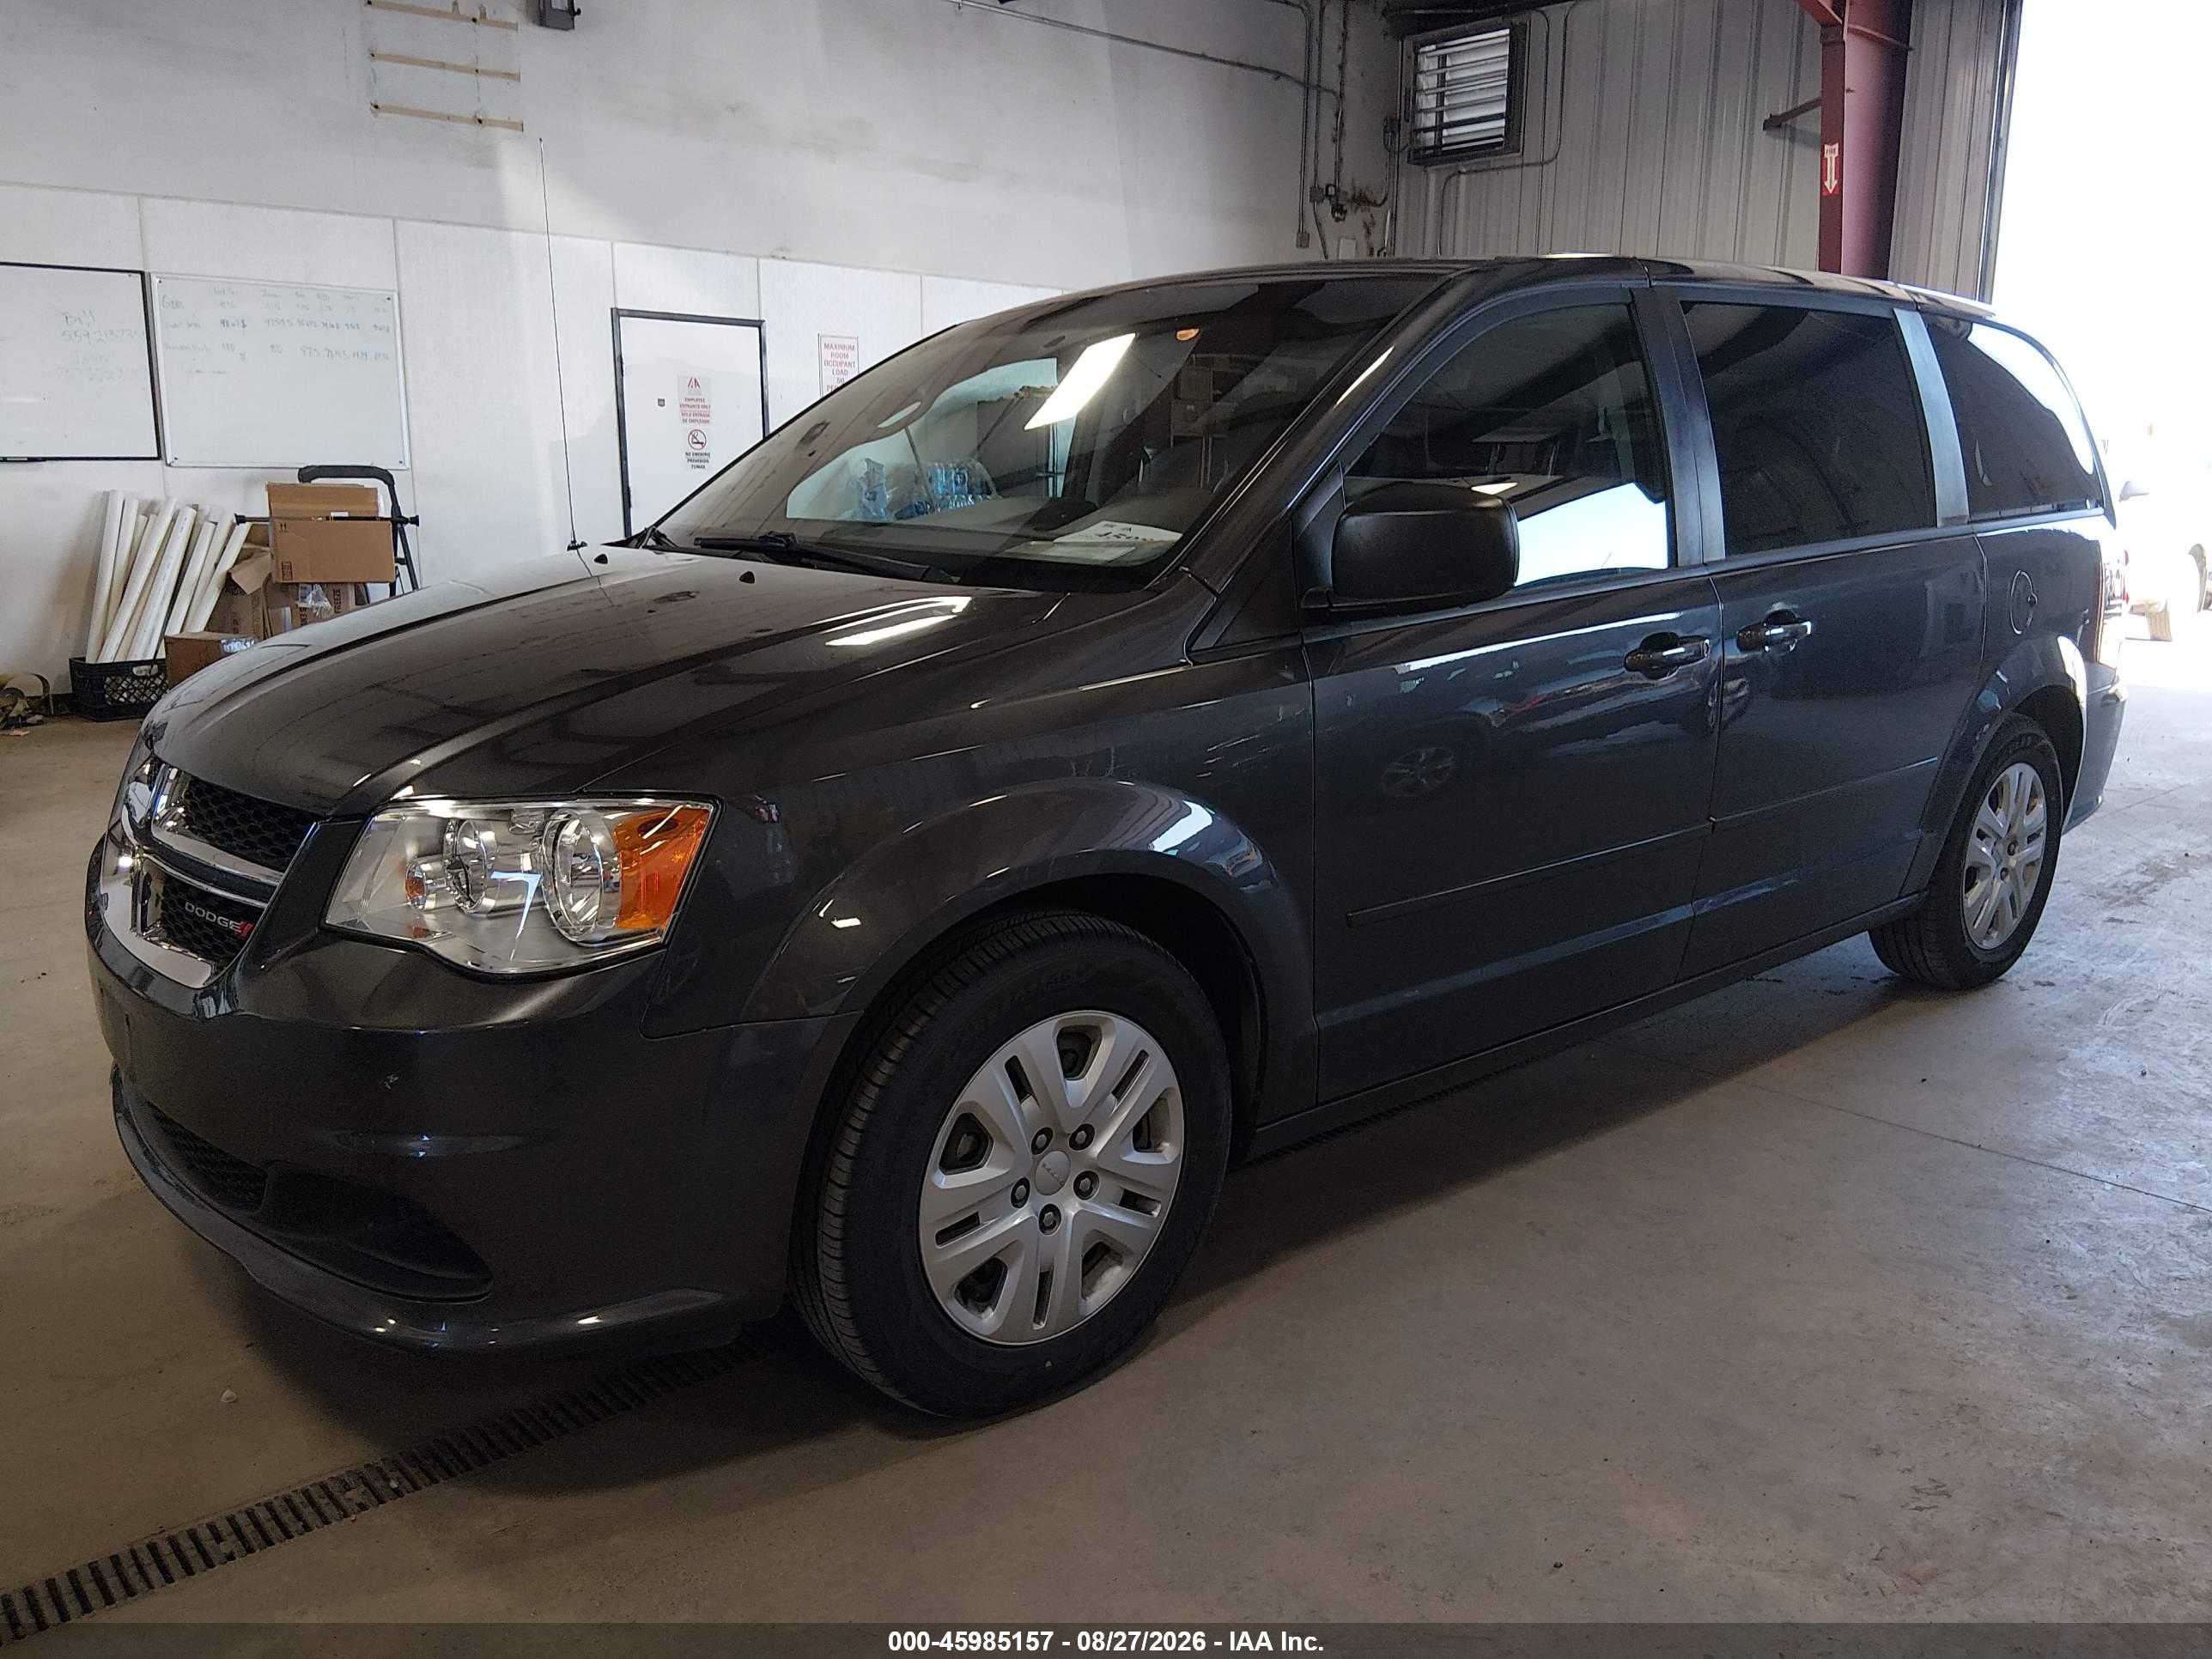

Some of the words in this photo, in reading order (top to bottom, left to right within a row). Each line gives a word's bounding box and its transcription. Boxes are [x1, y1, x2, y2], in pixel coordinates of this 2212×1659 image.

[823, 343, 855, 351] MAXIMUM
[823, 359, 855, 368] OCCUPANT
[832, 368, 848, 377] LOAD
[185, 901, 242, 933] DODGE
